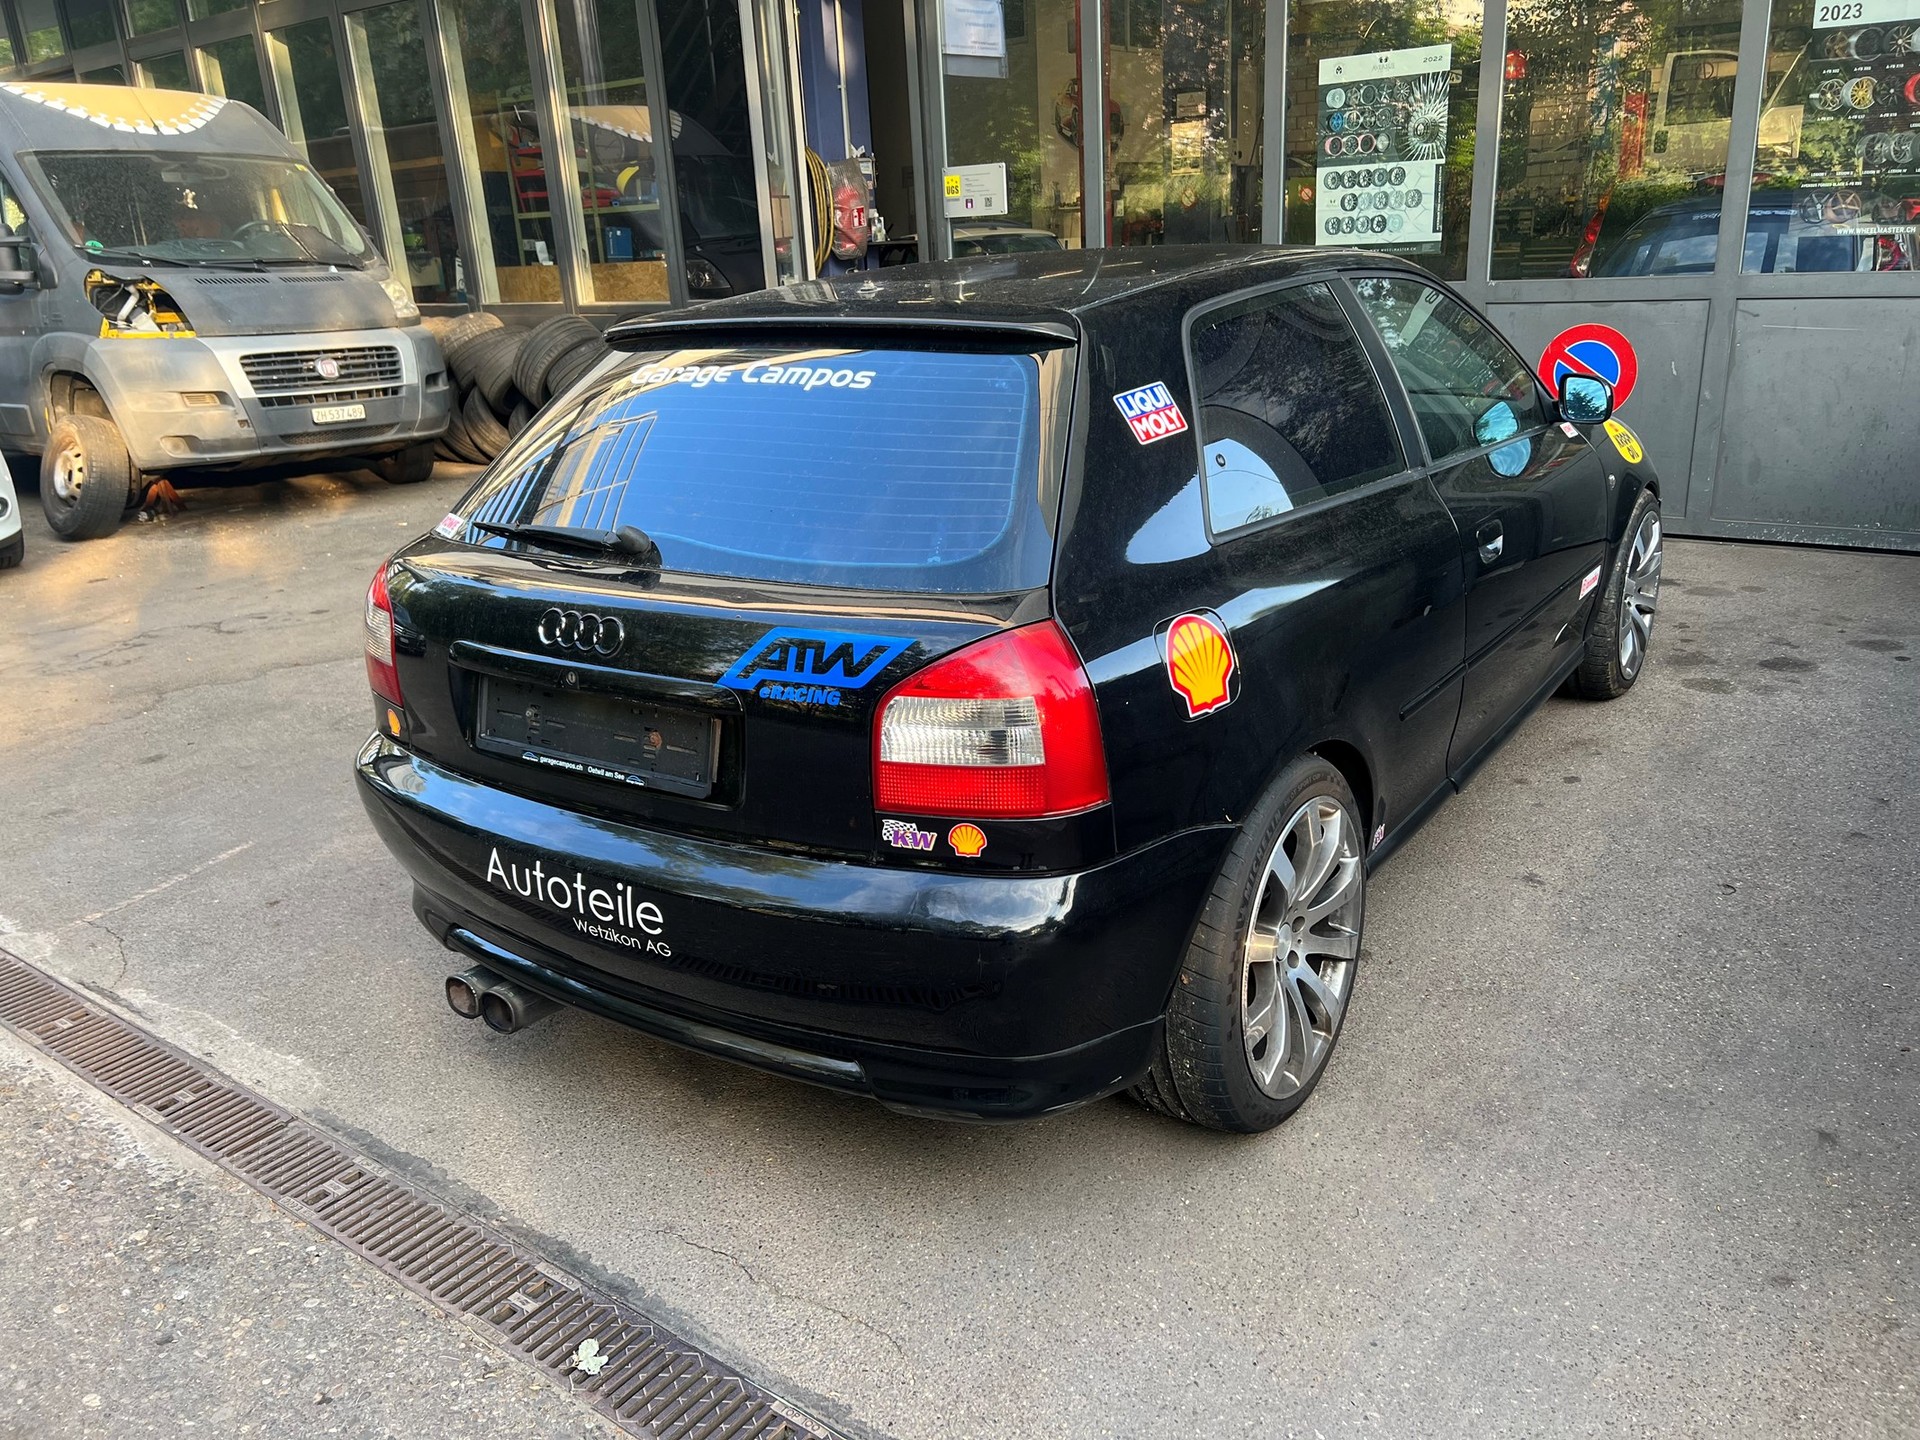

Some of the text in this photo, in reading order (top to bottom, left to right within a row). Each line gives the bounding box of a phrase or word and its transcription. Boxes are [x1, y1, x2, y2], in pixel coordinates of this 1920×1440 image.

[1819, 2, 1863, 22] 2023
[1422, 55, 1443, 63] 2022
[946, 185, 960, 195] UGS
[1836, 226, 1917, 235] WWW.WHEELMASTER.CH
[630, 362, 877, 391] Garage Campos
[1118, 385, 1172, 418] LIQUI
[1132, 407, 1182, 440] MOLY
[759, 685, 841, 706] eRACING
[892, 830, 936, 850] KW
[487, 847, 664, 935] Autoteile
[572, 917, 672, 957] Wetzikon AG
[780, 1404, 821, 1432] TOP 100
